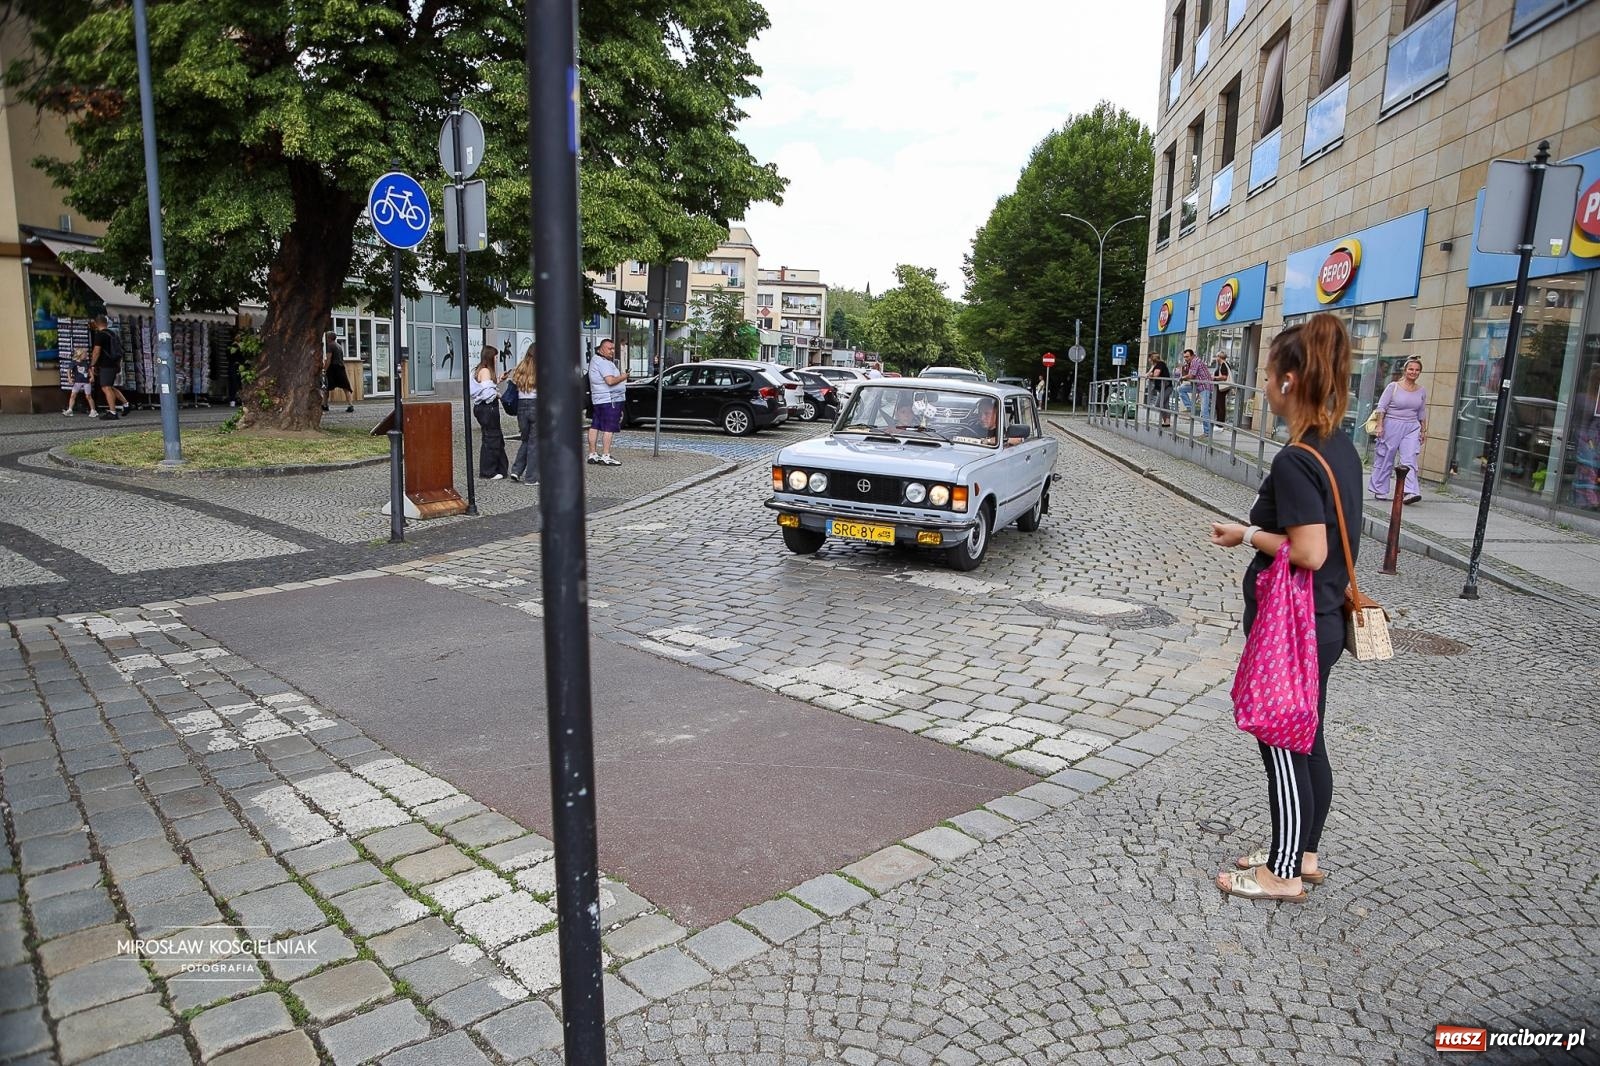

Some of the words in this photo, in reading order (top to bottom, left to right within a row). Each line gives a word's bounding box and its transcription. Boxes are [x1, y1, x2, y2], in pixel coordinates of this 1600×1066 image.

[1321, 260, 1349, 284] PEPCO
[1115, 346, 1124, 357] P
[834, 523, 856, 536] SRC
[861, 527, 875, 538] 8Y
